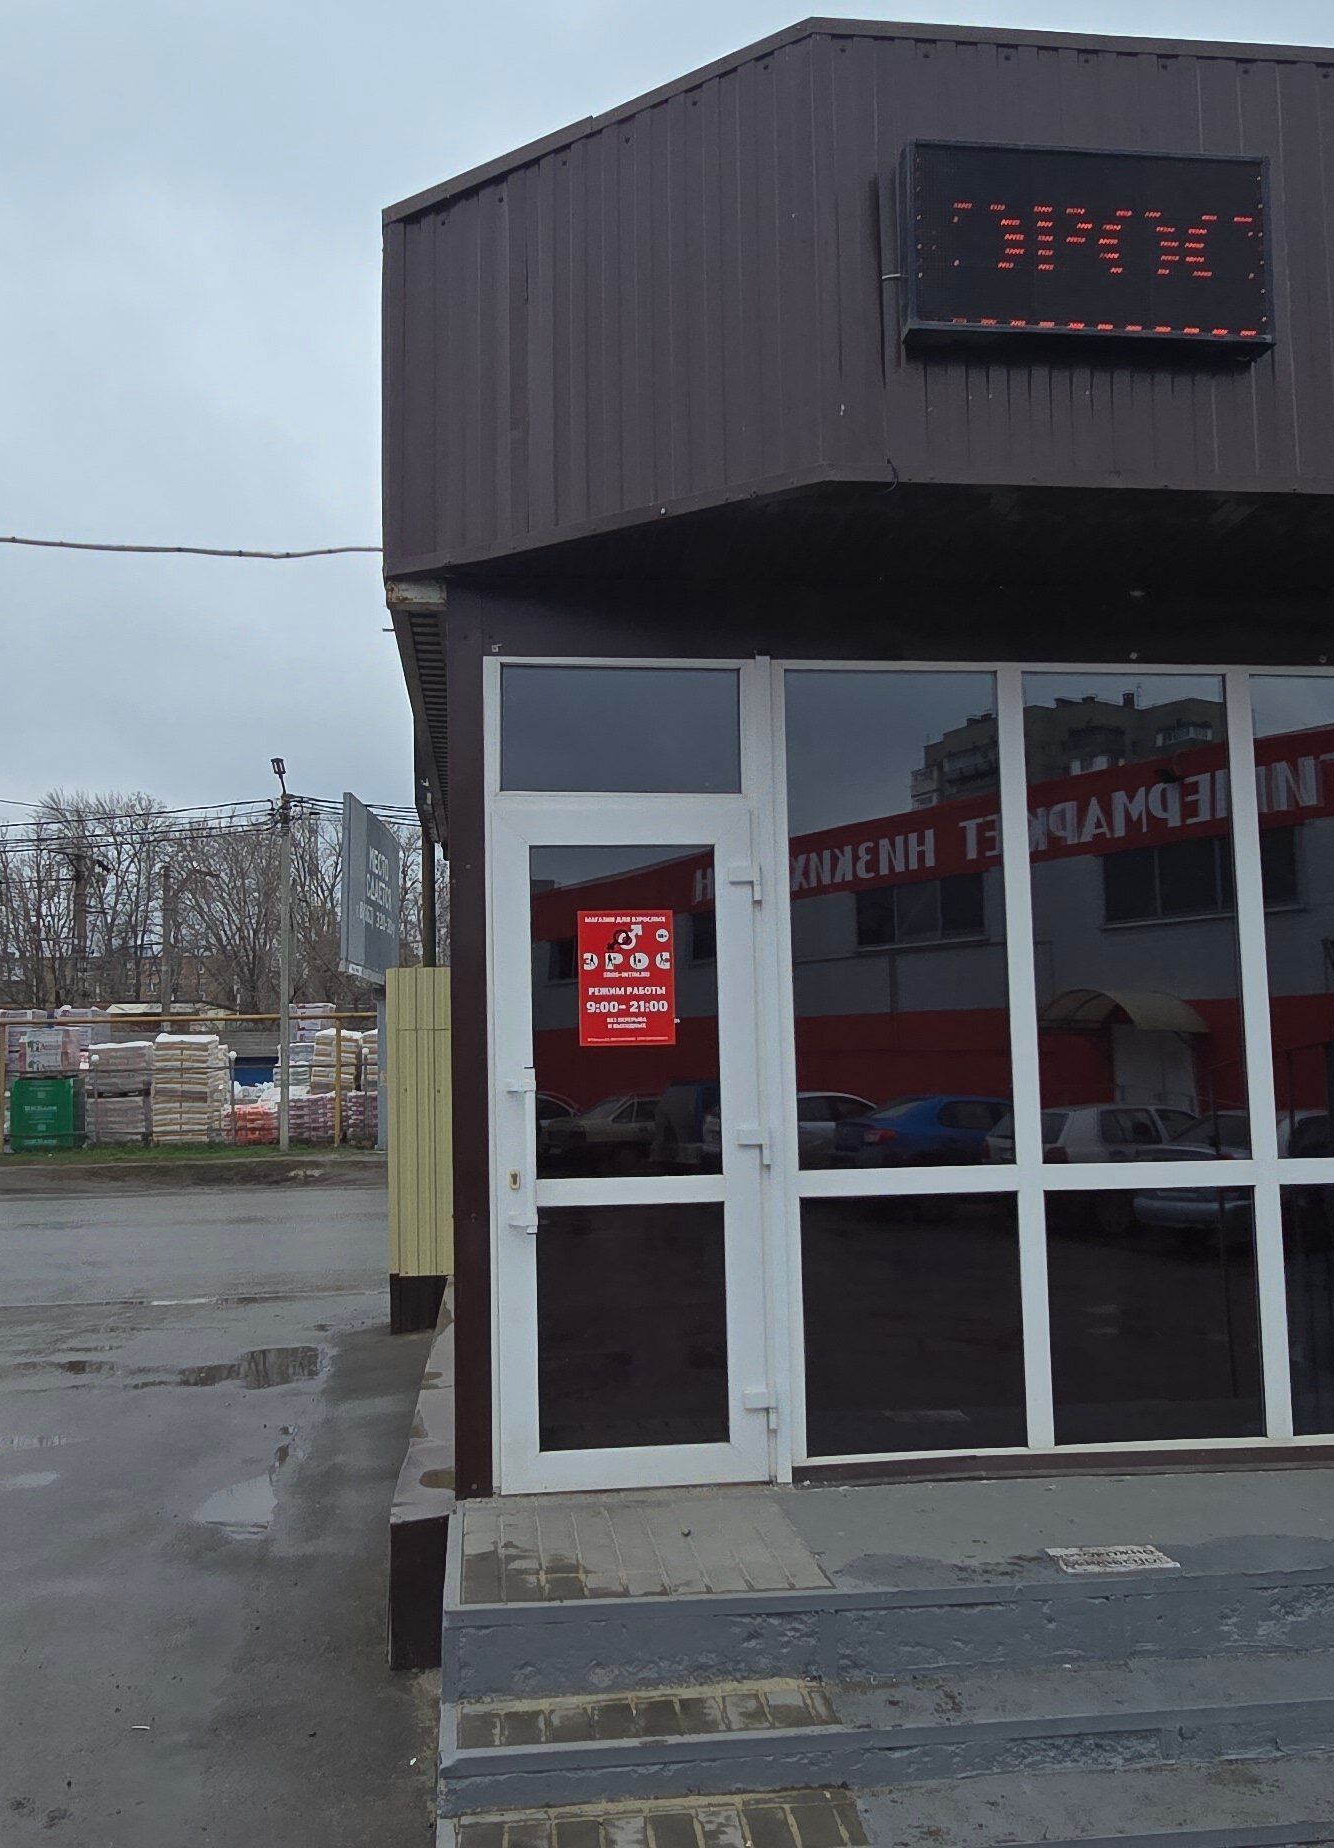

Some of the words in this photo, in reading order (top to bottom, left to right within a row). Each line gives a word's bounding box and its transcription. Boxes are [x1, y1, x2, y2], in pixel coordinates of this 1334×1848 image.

[583, 951, 671, 971] ЭРОС
[588, 986, 625, 996] РЕЖИМ
[627, 986, 666, 995] РАБОТЫ
[629, 1001, 668, 1012] 21:00
